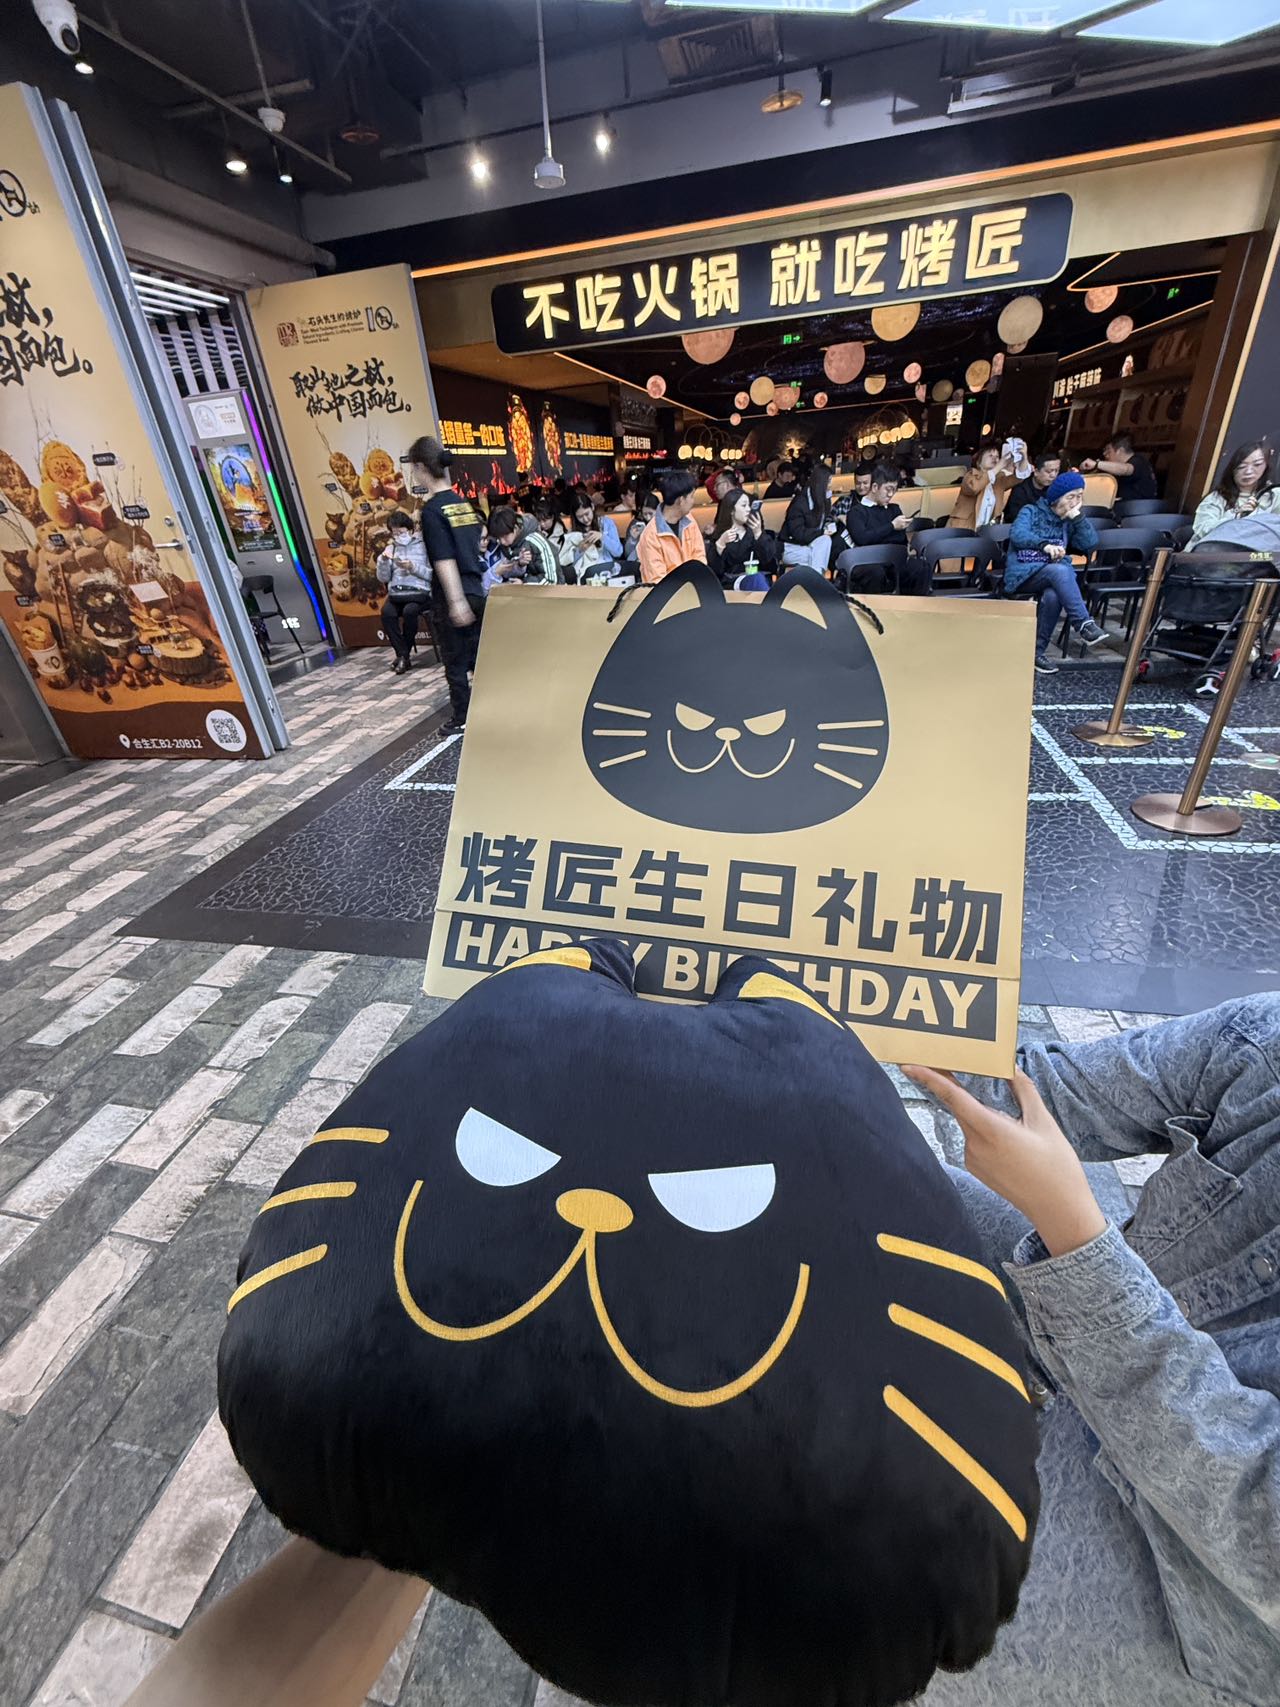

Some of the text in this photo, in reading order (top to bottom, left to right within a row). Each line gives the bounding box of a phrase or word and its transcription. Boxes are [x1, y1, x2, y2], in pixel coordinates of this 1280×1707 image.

[523, 206, 1028, 340] 不吃火锅 就吃烤匠
[455, 831, 1003, 966] 烤匠生日礼物
[454, 919, 984, 1029] HAY BIHDAY
